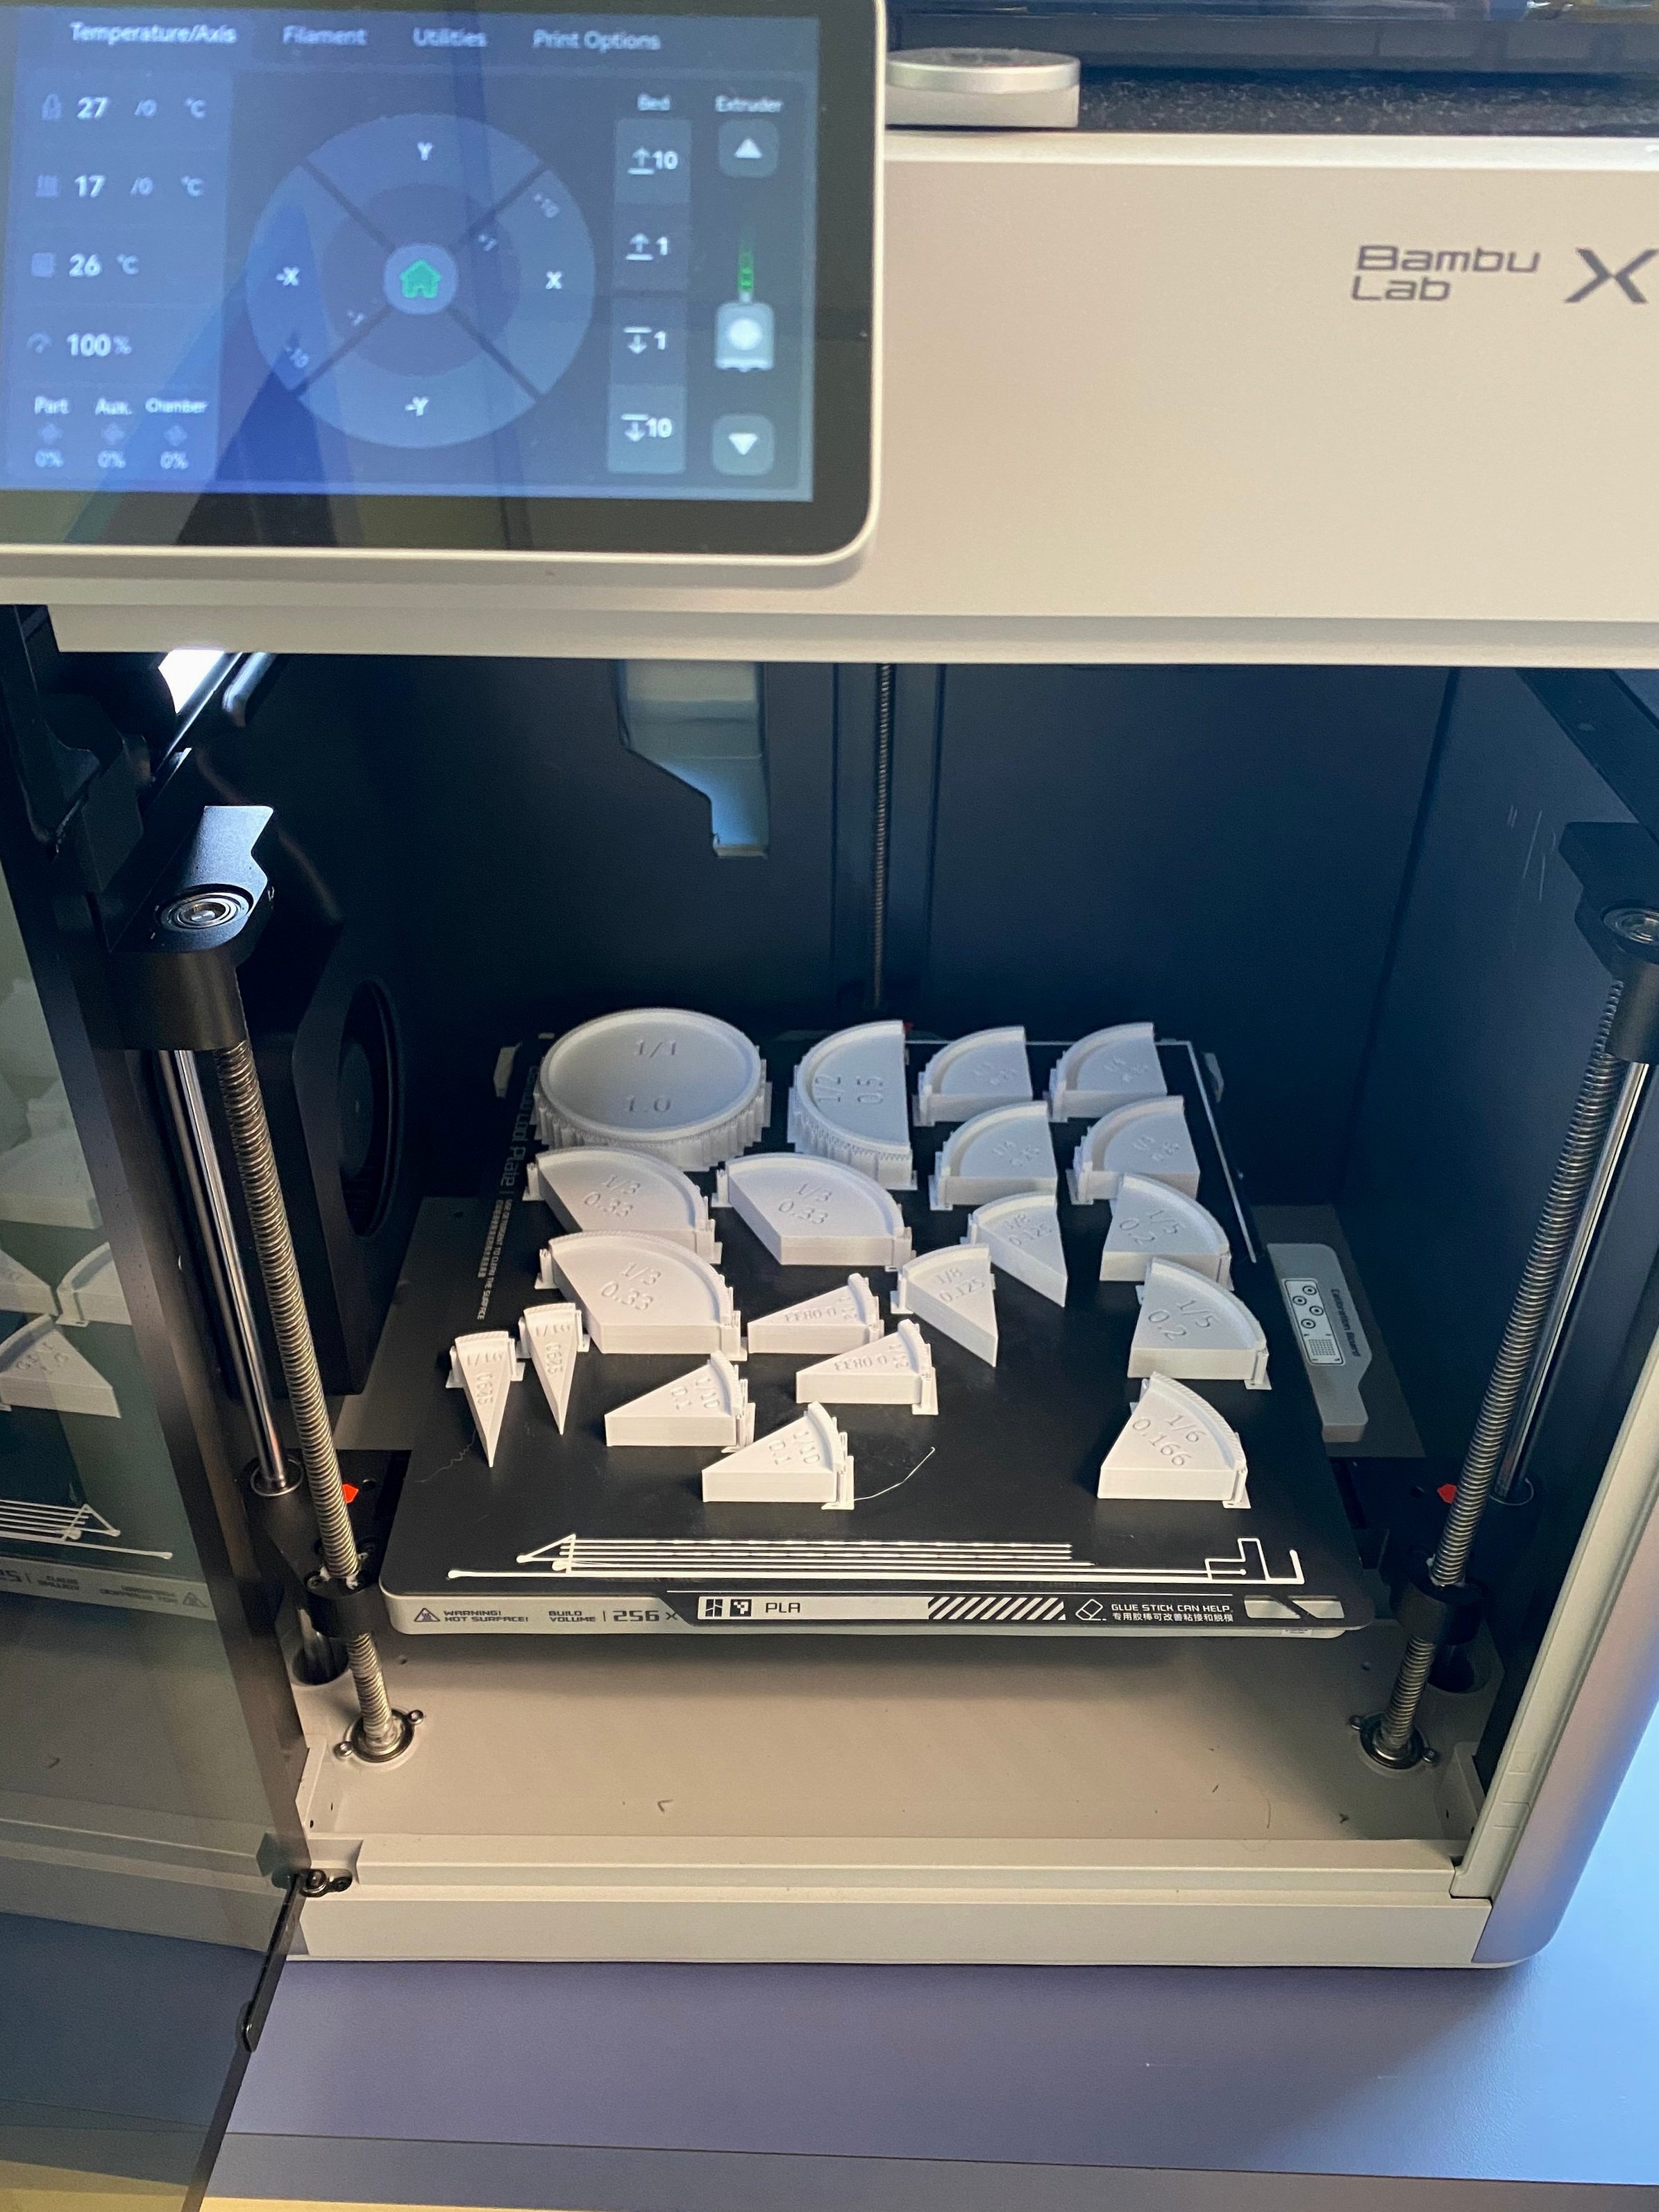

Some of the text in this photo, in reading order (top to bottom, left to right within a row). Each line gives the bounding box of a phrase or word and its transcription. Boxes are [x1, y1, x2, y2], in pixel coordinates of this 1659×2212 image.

[70, 22, 237, 45] Temperature/Axis
[283, 25, 368, 45] Filament
[413, 26, 487, 47] Utilities
[533, 29, 662, 53] Print Options
[77, 96, 110, 119] 27
[637, 93, 671, 112] Bed
[715, 95, 784, 114] Extruder
[417, 142, 433, 161] Y
[652, 151, 678, 171] 10
[75, 174, 106, 197] 17
[657, 237, 670, 256] 1
[69, 253, 102, 276] 26
[1356, 245, 1541, 273] Bambu
[546, 271, 563, 290] X
[1563, 248, 1659, 303] X
[1351, 275, 1451, 302] Lab
[654, 331, 667, 351] 1
[35, 396, 69, 414] Part
[646, 418, 673, 439] 10
[634, 1039, 677, 1058] 1/1
[500, 1146, 526, 1186] Plate
[604, 1175, 641, 1194] 1/3
[797, 1182, 833, 1203] 1/3
[584, 1192, 634, 1218] 0.33
[778, 1198, 830, 1225] 0.33
[1120, 1218, 1155, 1246] 0.2
[1149, 1209, 1186, 1234] 1/5
[622, 1262, 662, 1286] 1/3
[601, 1282, 654, 1311] 0.33
[1148, 1309, 1187, 1341] 0.2
[1177, 1299, 1218, 1329] 1/5
[1166, 1414, 1206, 1443] 1/6
[1132, 1418, 1192, 1466] 0.166
[613, 1610, 659, 1623] 256
[766, 1602, 800, 1614] PLA
